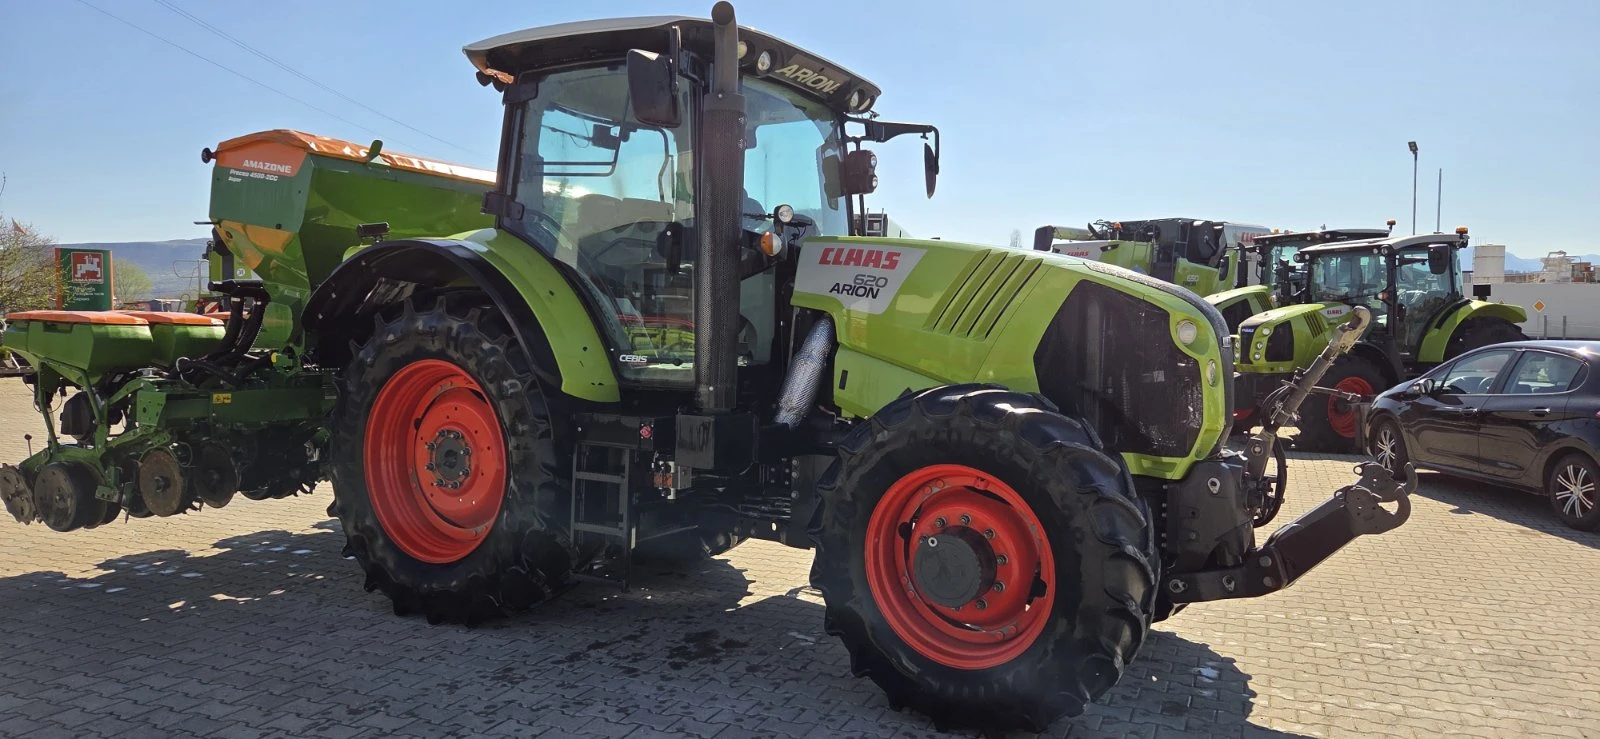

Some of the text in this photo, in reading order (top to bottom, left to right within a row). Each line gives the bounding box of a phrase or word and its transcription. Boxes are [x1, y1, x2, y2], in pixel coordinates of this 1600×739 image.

[775, 64, 841, 93] ARION
[242, 159, 293, 174] AMAZONE
[818, 247, 902, 271] CLAAS
[853, 273, 889, 288] 620
[829, 282, 881, 300] ARION
[619, 354, 648, 363] CEBIS
